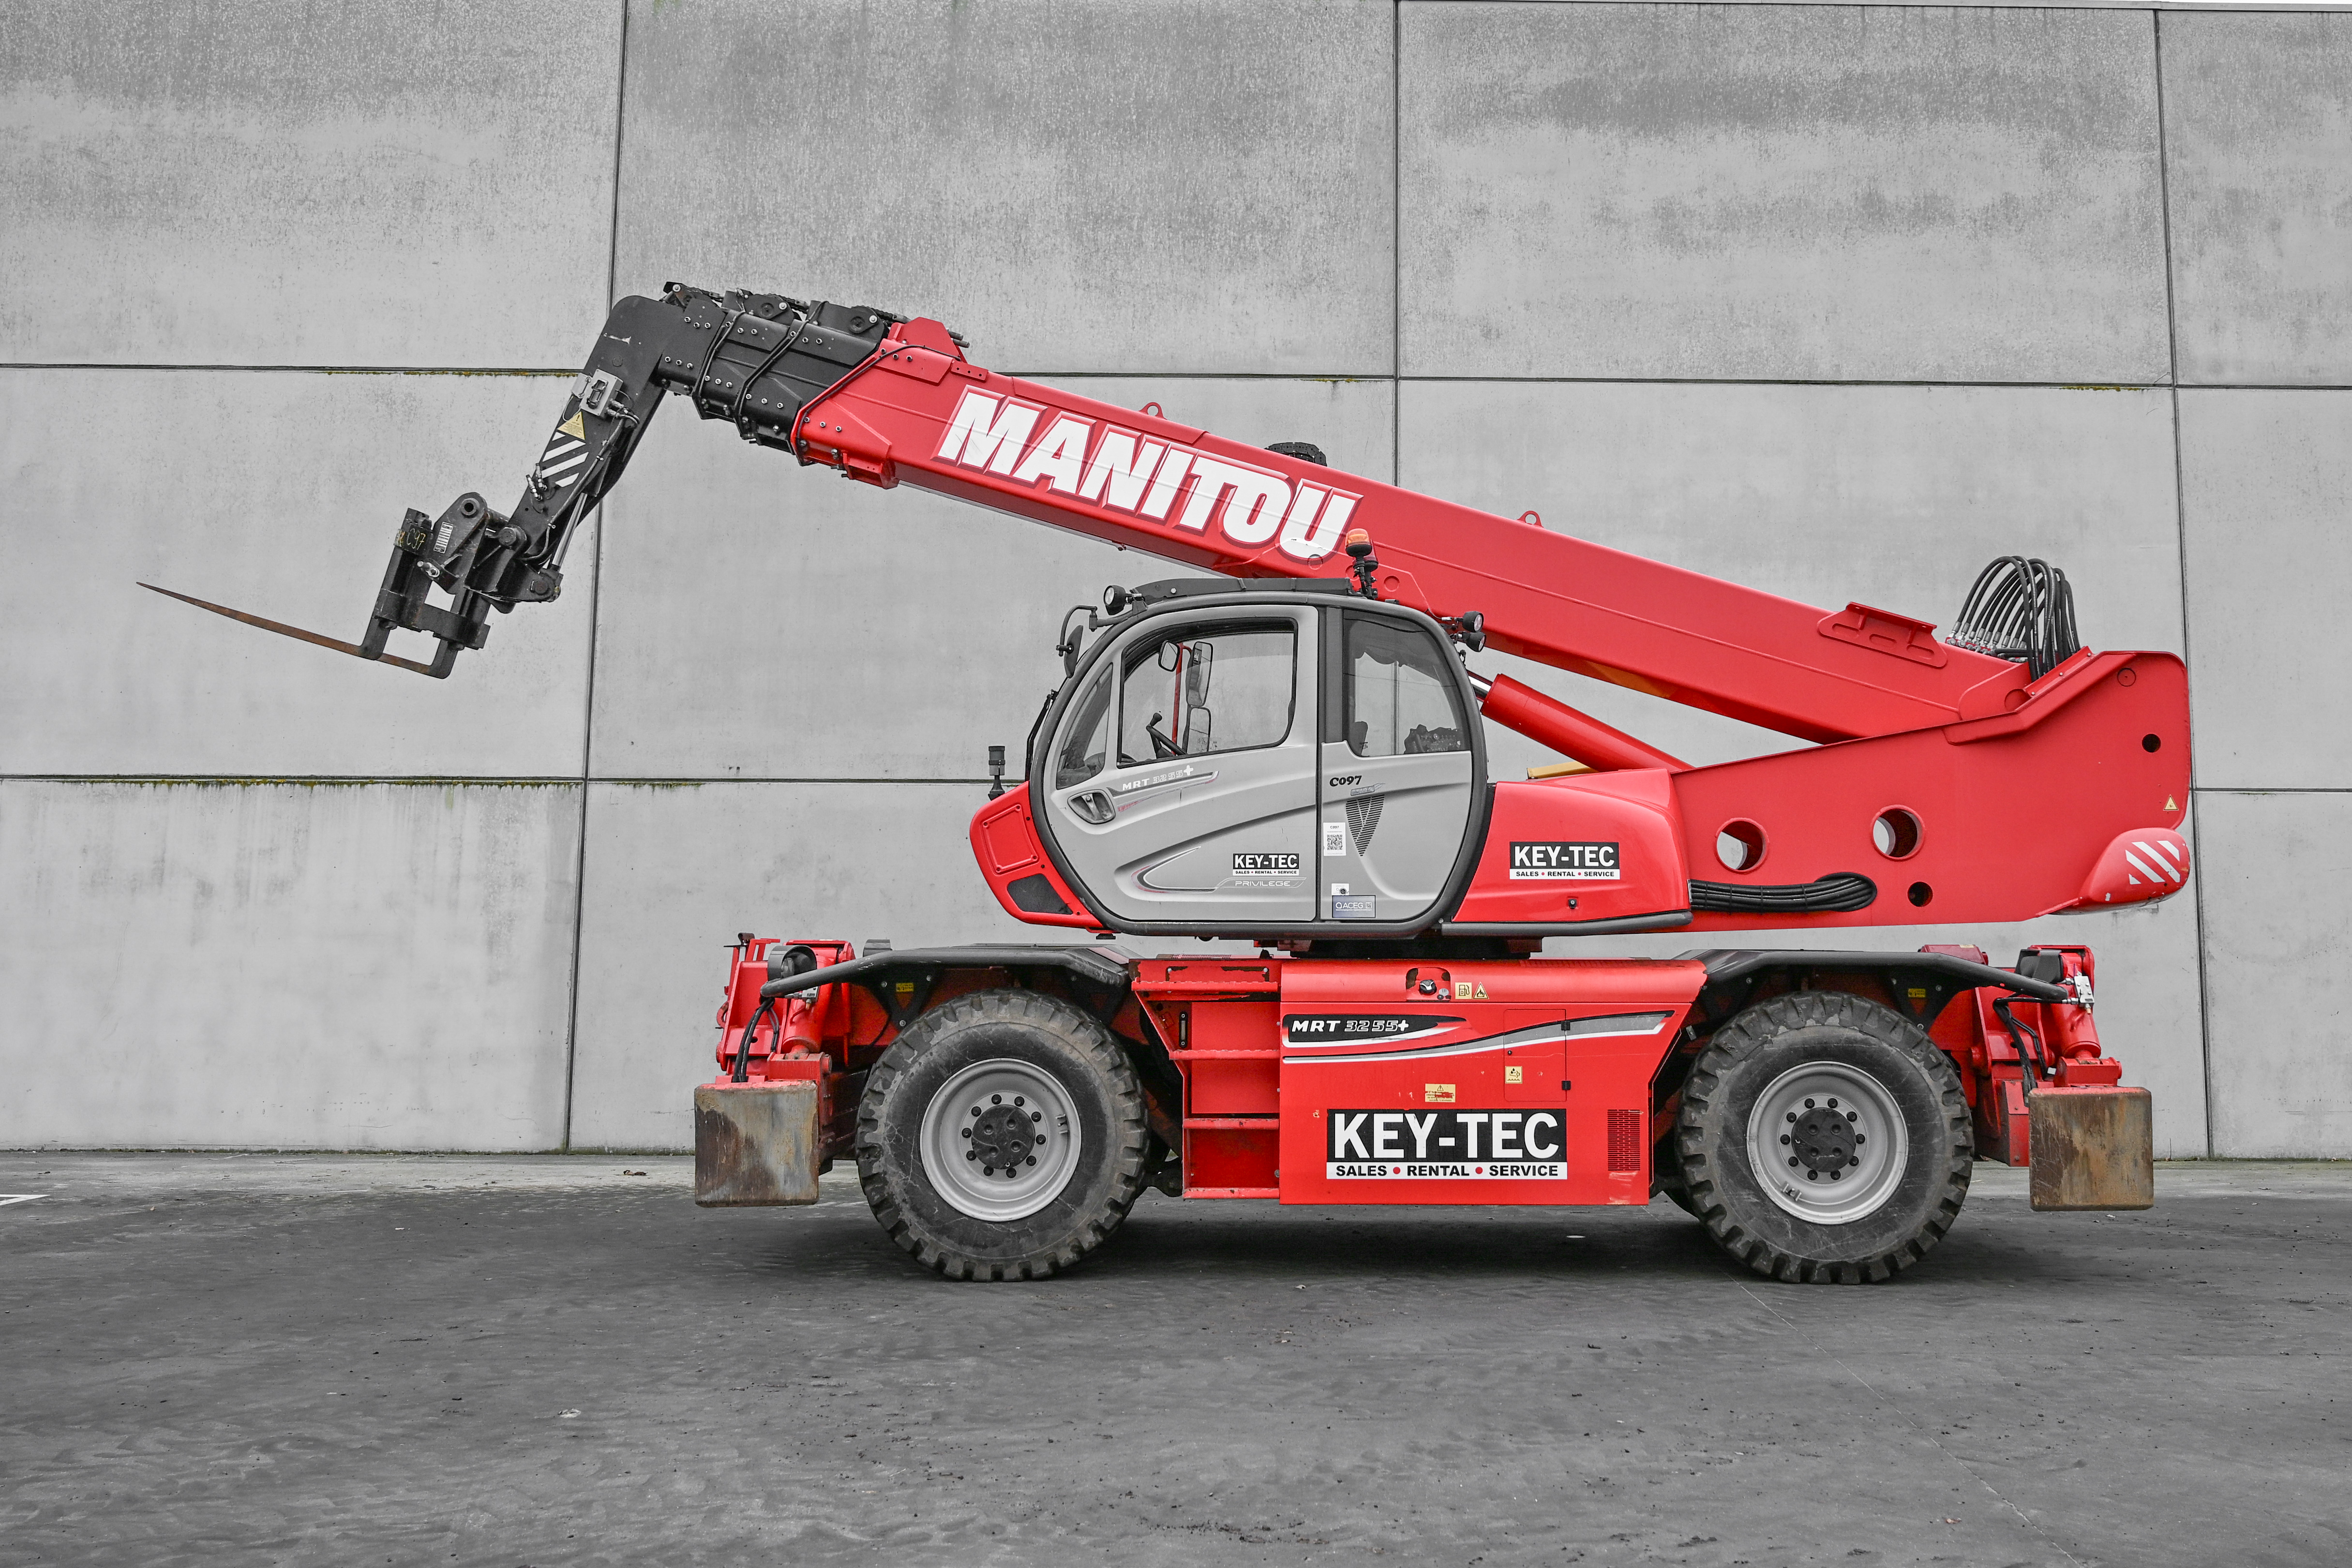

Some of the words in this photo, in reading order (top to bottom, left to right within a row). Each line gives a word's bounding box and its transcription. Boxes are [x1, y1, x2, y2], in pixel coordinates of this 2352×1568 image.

[932, 385, 1363, 564] MANITOU
[1122, 778, 1150, 791] MRT
[1329, 775, 1362, 787] C097
[1234, 854, 1298, 868] KEY-TEC
[1514, 846, 1615, 867] KEY-TEC
[1291, 1020, 1341, 1032] MRT
[1334, 1112, 1559, 1159] KEY-TEC
[1336, 1165, 1387, 1176] SALES
[1407, 1165, 1470, 1176] RENTAL
[1489, 1165, 1558, 1176] SERVICE
